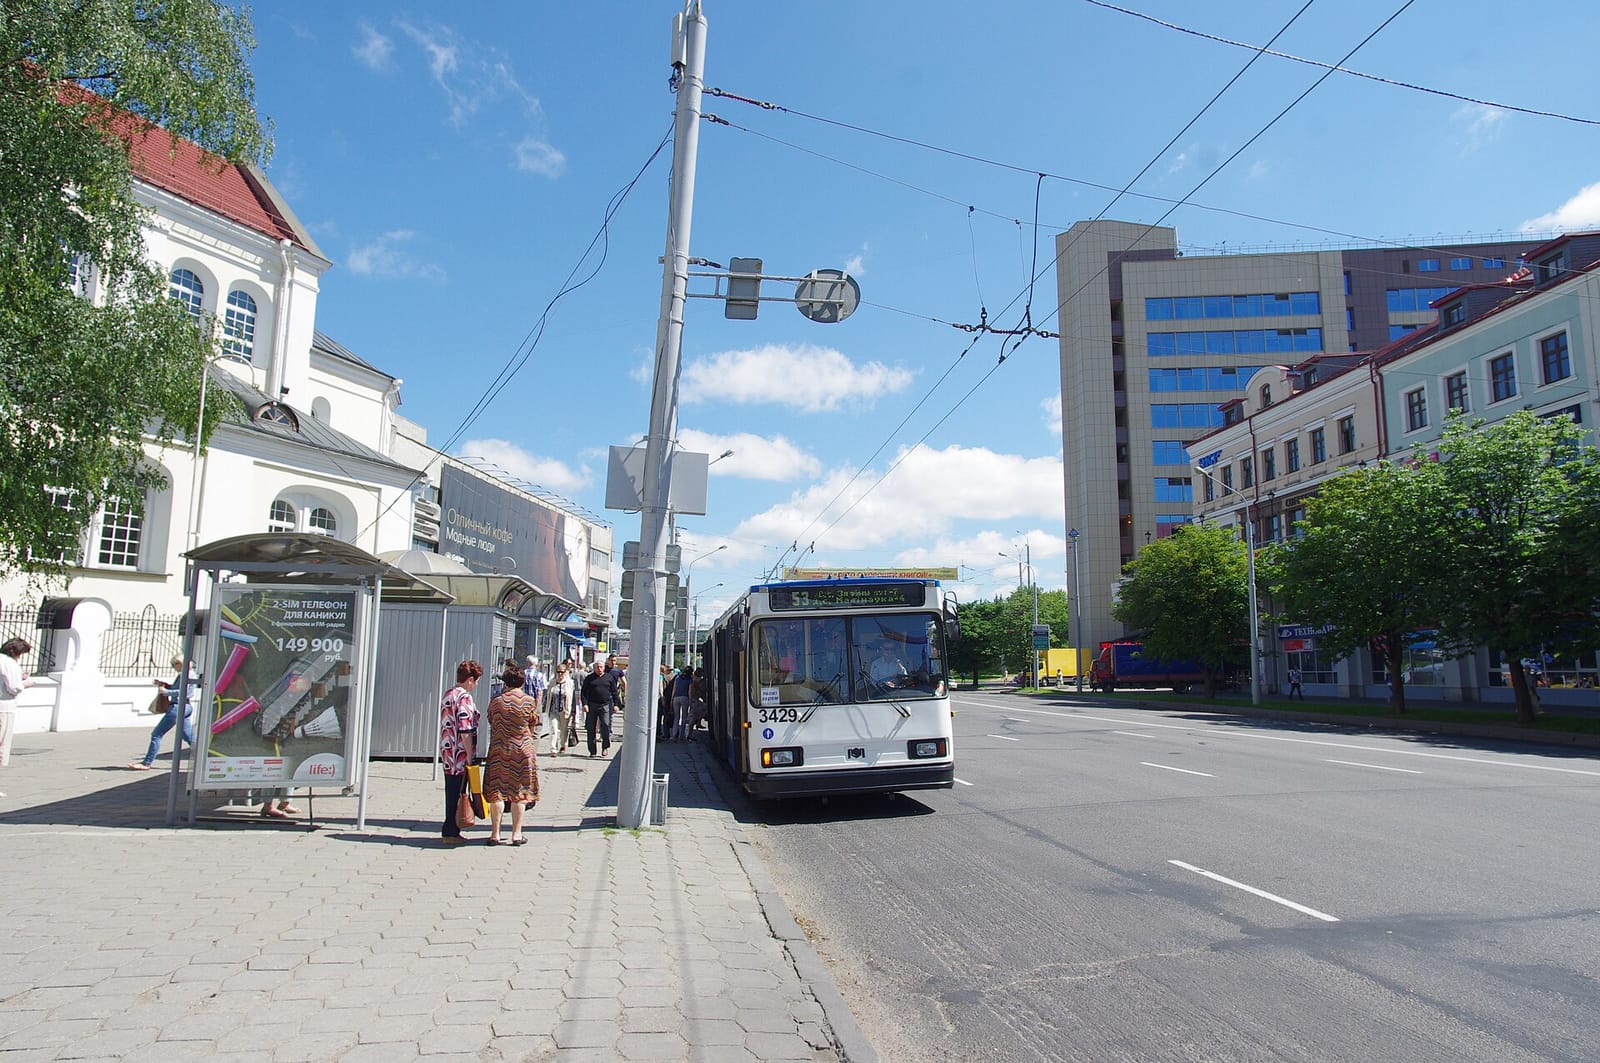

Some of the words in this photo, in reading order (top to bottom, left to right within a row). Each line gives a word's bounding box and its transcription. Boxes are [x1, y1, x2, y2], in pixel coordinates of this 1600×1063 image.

[447, 508, 491, 536] Отличный
[492, 527, 513, 545] кофе
[445, 526, 477, 548] Модные
[477, 539, 496, 554] люди
[301, 601, 347, 609] ТЕЛЕФОН
[791, 591, 809, 606] 53
[283, 611, 303, 620] ДЛЯ
[304, 612, 346, 620] КАНИКУЛ
[325, 653, 342, 662] руб.
[759, 708, 797, 723] 3429
